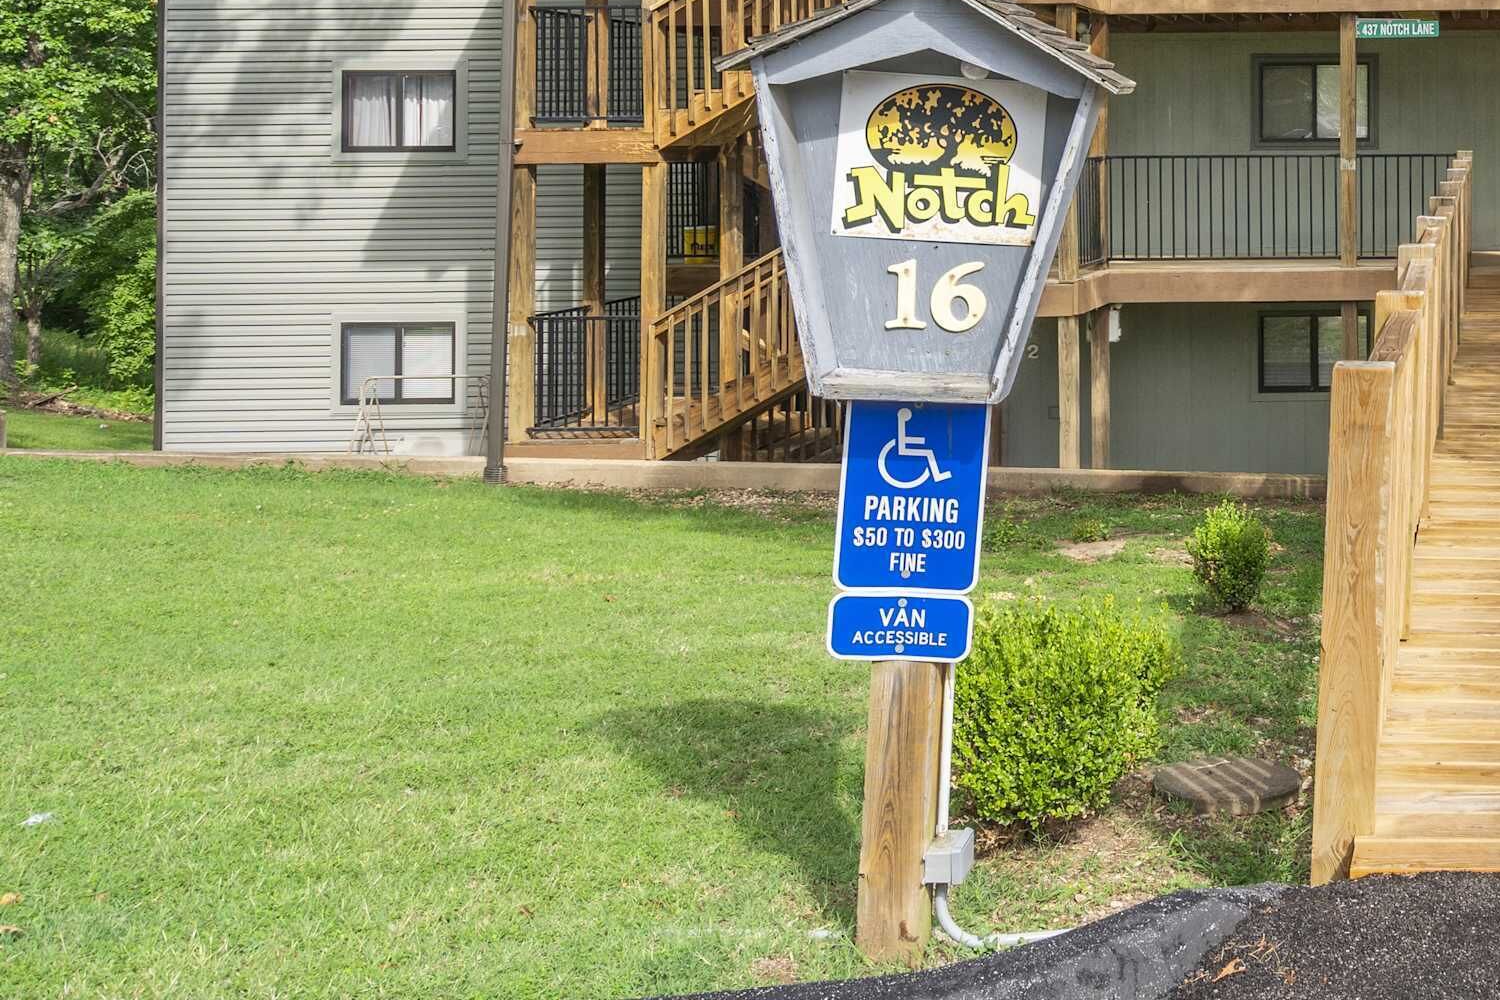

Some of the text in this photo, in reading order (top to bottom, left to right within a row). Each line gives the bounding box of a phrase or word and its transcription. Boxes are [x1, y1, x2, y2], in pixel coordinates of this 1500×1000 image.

[1362, 23, 1434, 36] 437 NOTCH LANE
[844, 164, 1035, 232] Notch
[885, 258, 987, 333] 16
[1027, 344, 1040, 359] 2
[864, 495, 960, 524] PARKING
[853, 527, 966, 550] $50 TO $300
[889, 552, 927, 573] FINE
[879, 607, 926, 628] VAN
[852, 630, 948, 647] ACCESSIBLE
